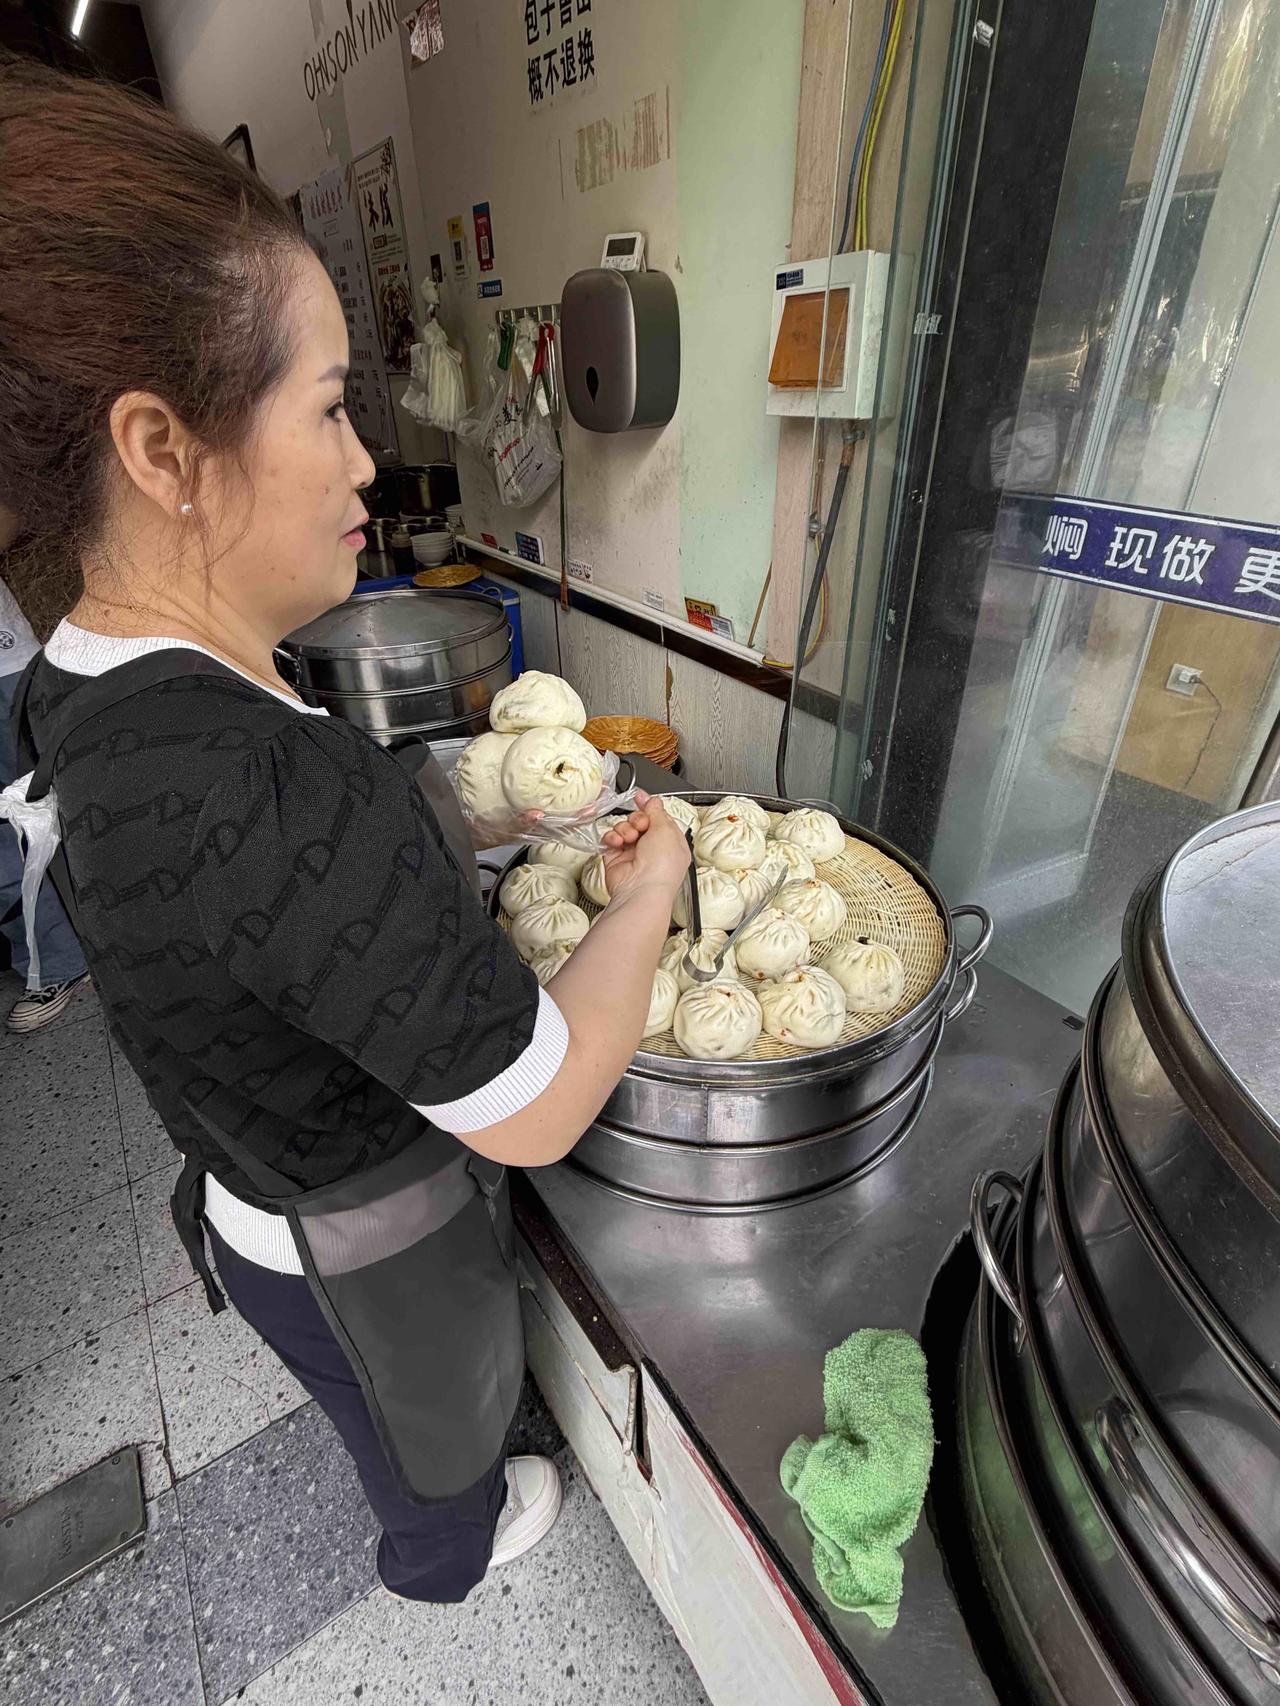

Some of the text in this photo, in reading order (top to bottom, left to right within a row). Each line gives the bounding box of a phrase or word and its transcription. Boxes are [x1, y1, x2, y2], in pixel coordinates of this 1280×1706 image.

[527, 28, 596, 105] 概不退换
[1104, 525, 1216, 586] 现做
